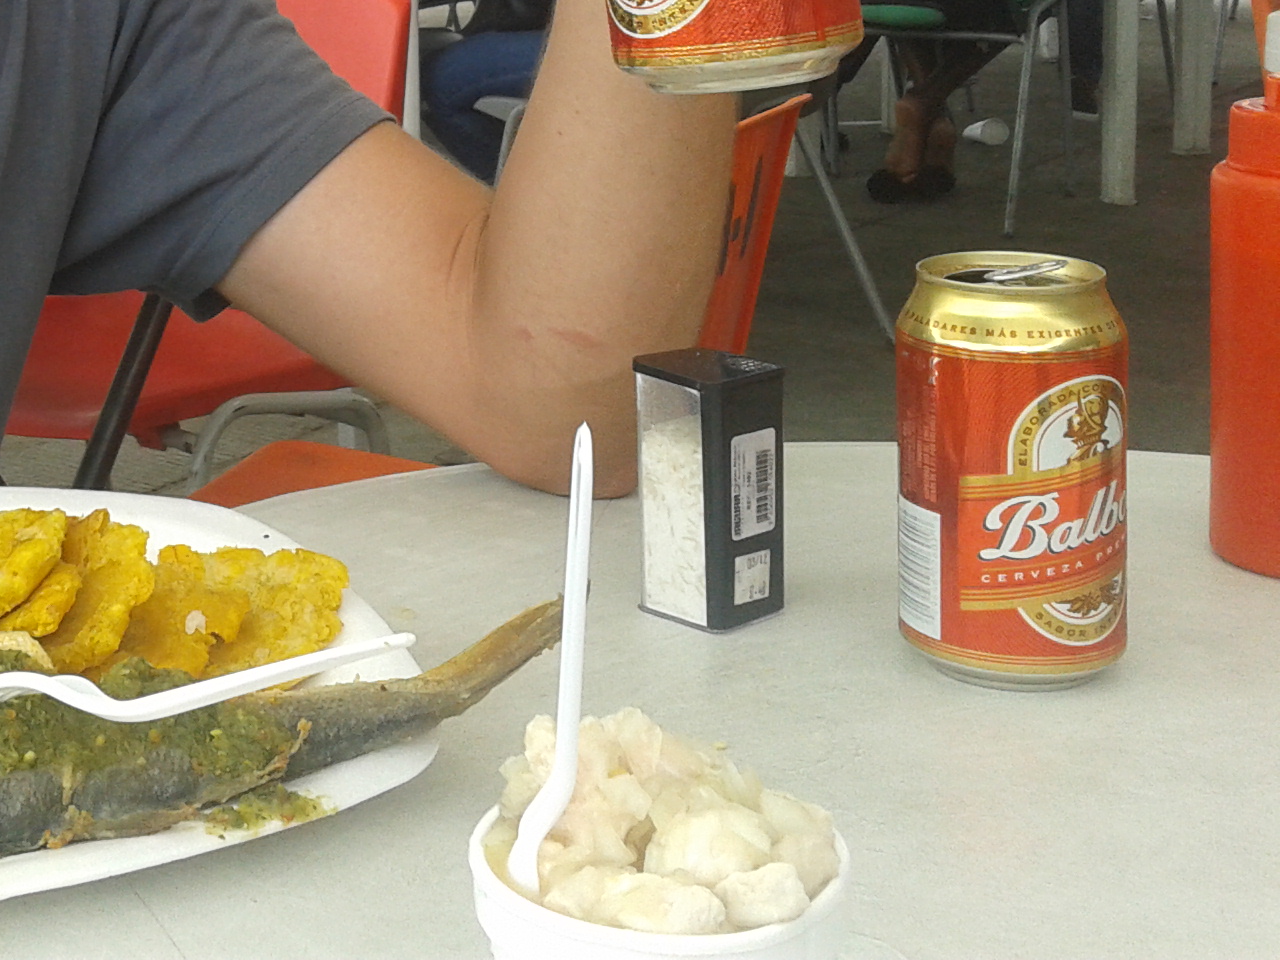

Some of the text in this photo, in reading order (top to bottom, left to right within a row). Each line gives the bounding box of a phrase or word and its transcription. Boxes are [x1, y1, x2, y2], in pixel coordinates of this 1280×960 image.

[1026, 324, 1103, 340] EXIGENTES
[1018, 383, 1106, 467] ELABORADA CO
[980, 560, 1084, 583] CERVEZA
